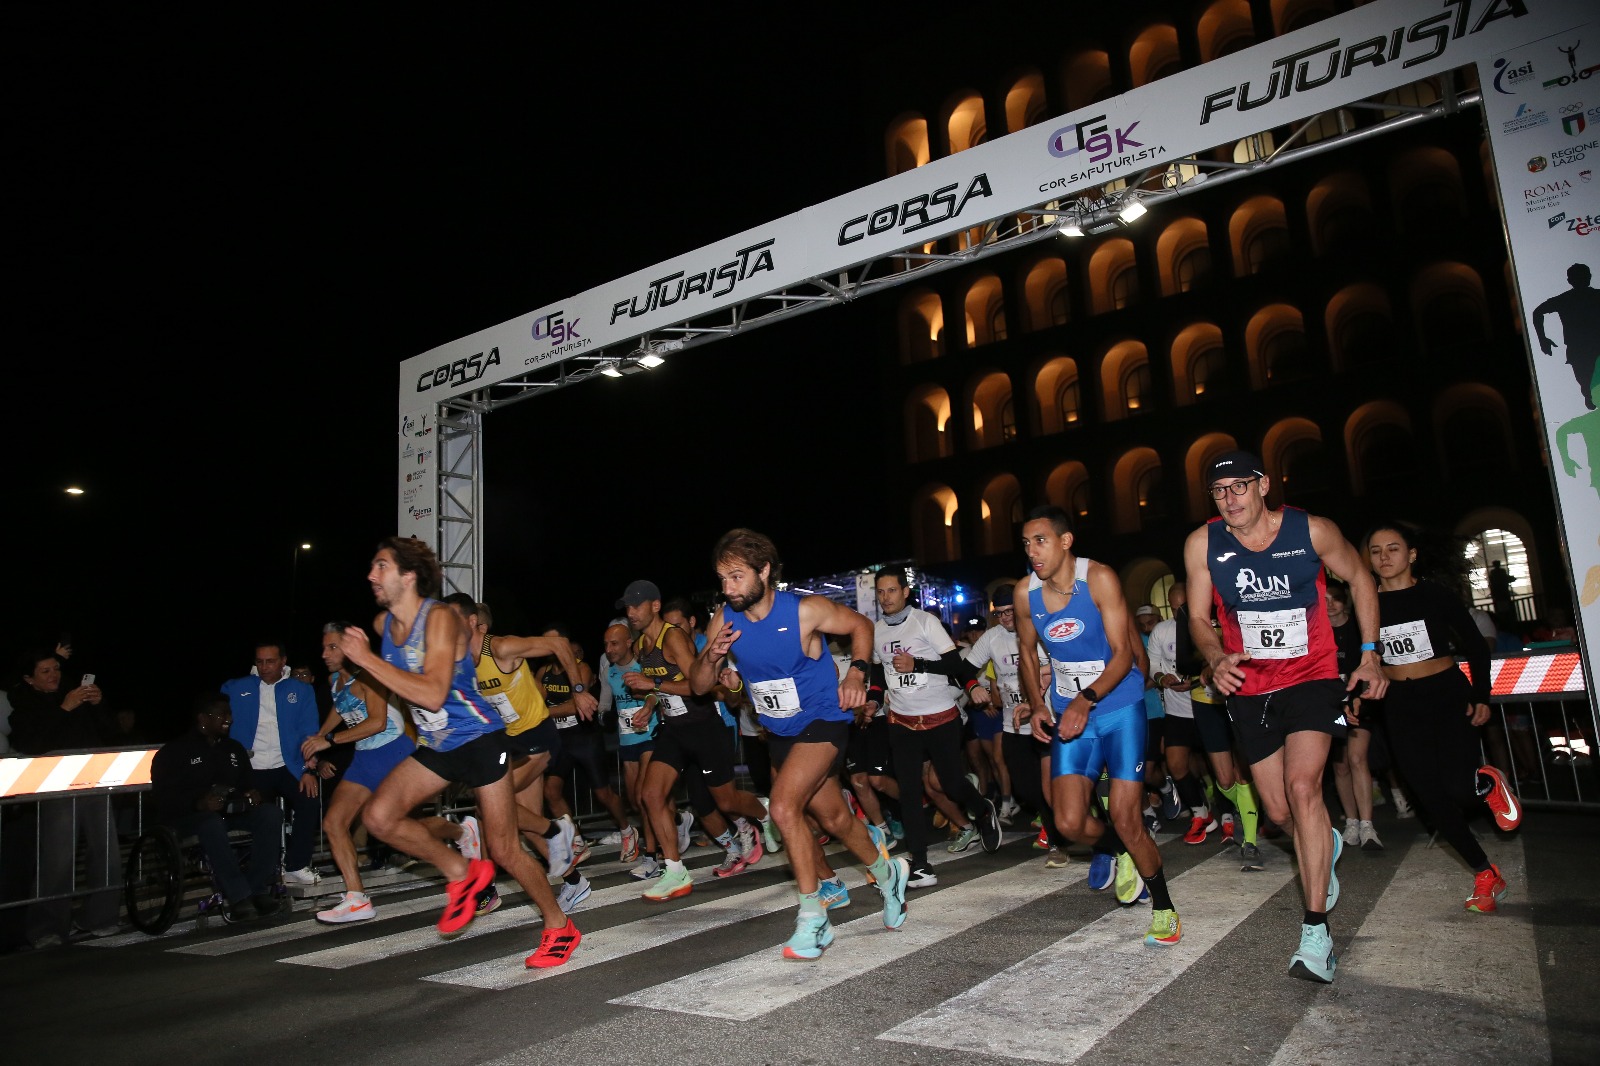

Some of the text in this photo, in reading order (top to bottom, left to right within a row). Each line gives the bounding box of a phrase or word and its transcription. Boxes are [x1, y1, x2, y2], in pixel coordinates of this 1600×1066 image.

[1200, 0, 1528, 125] FUTURISTA
[1507, 61, 1535, 79] asi
[1552, 141, 1599, 160] REGIONE
[1553, 153, 1585, 167] LAZIO
[1524, 180, 1572, 199] ROMA
[837, 173, 993, 247] CORSA
[1550, 214, 1565, 223] con
[609, 238, 776, 325] FUTURISTA
[416, 347, 501, 392] CORSA
[1235, 568, 1290, 594] RUN
[1260, 628, 1286, 648] 62
[1386, 638, 1415, 656] 108
[898, 674, 917, 687] 142
[763, 694, 780, 709] 91
